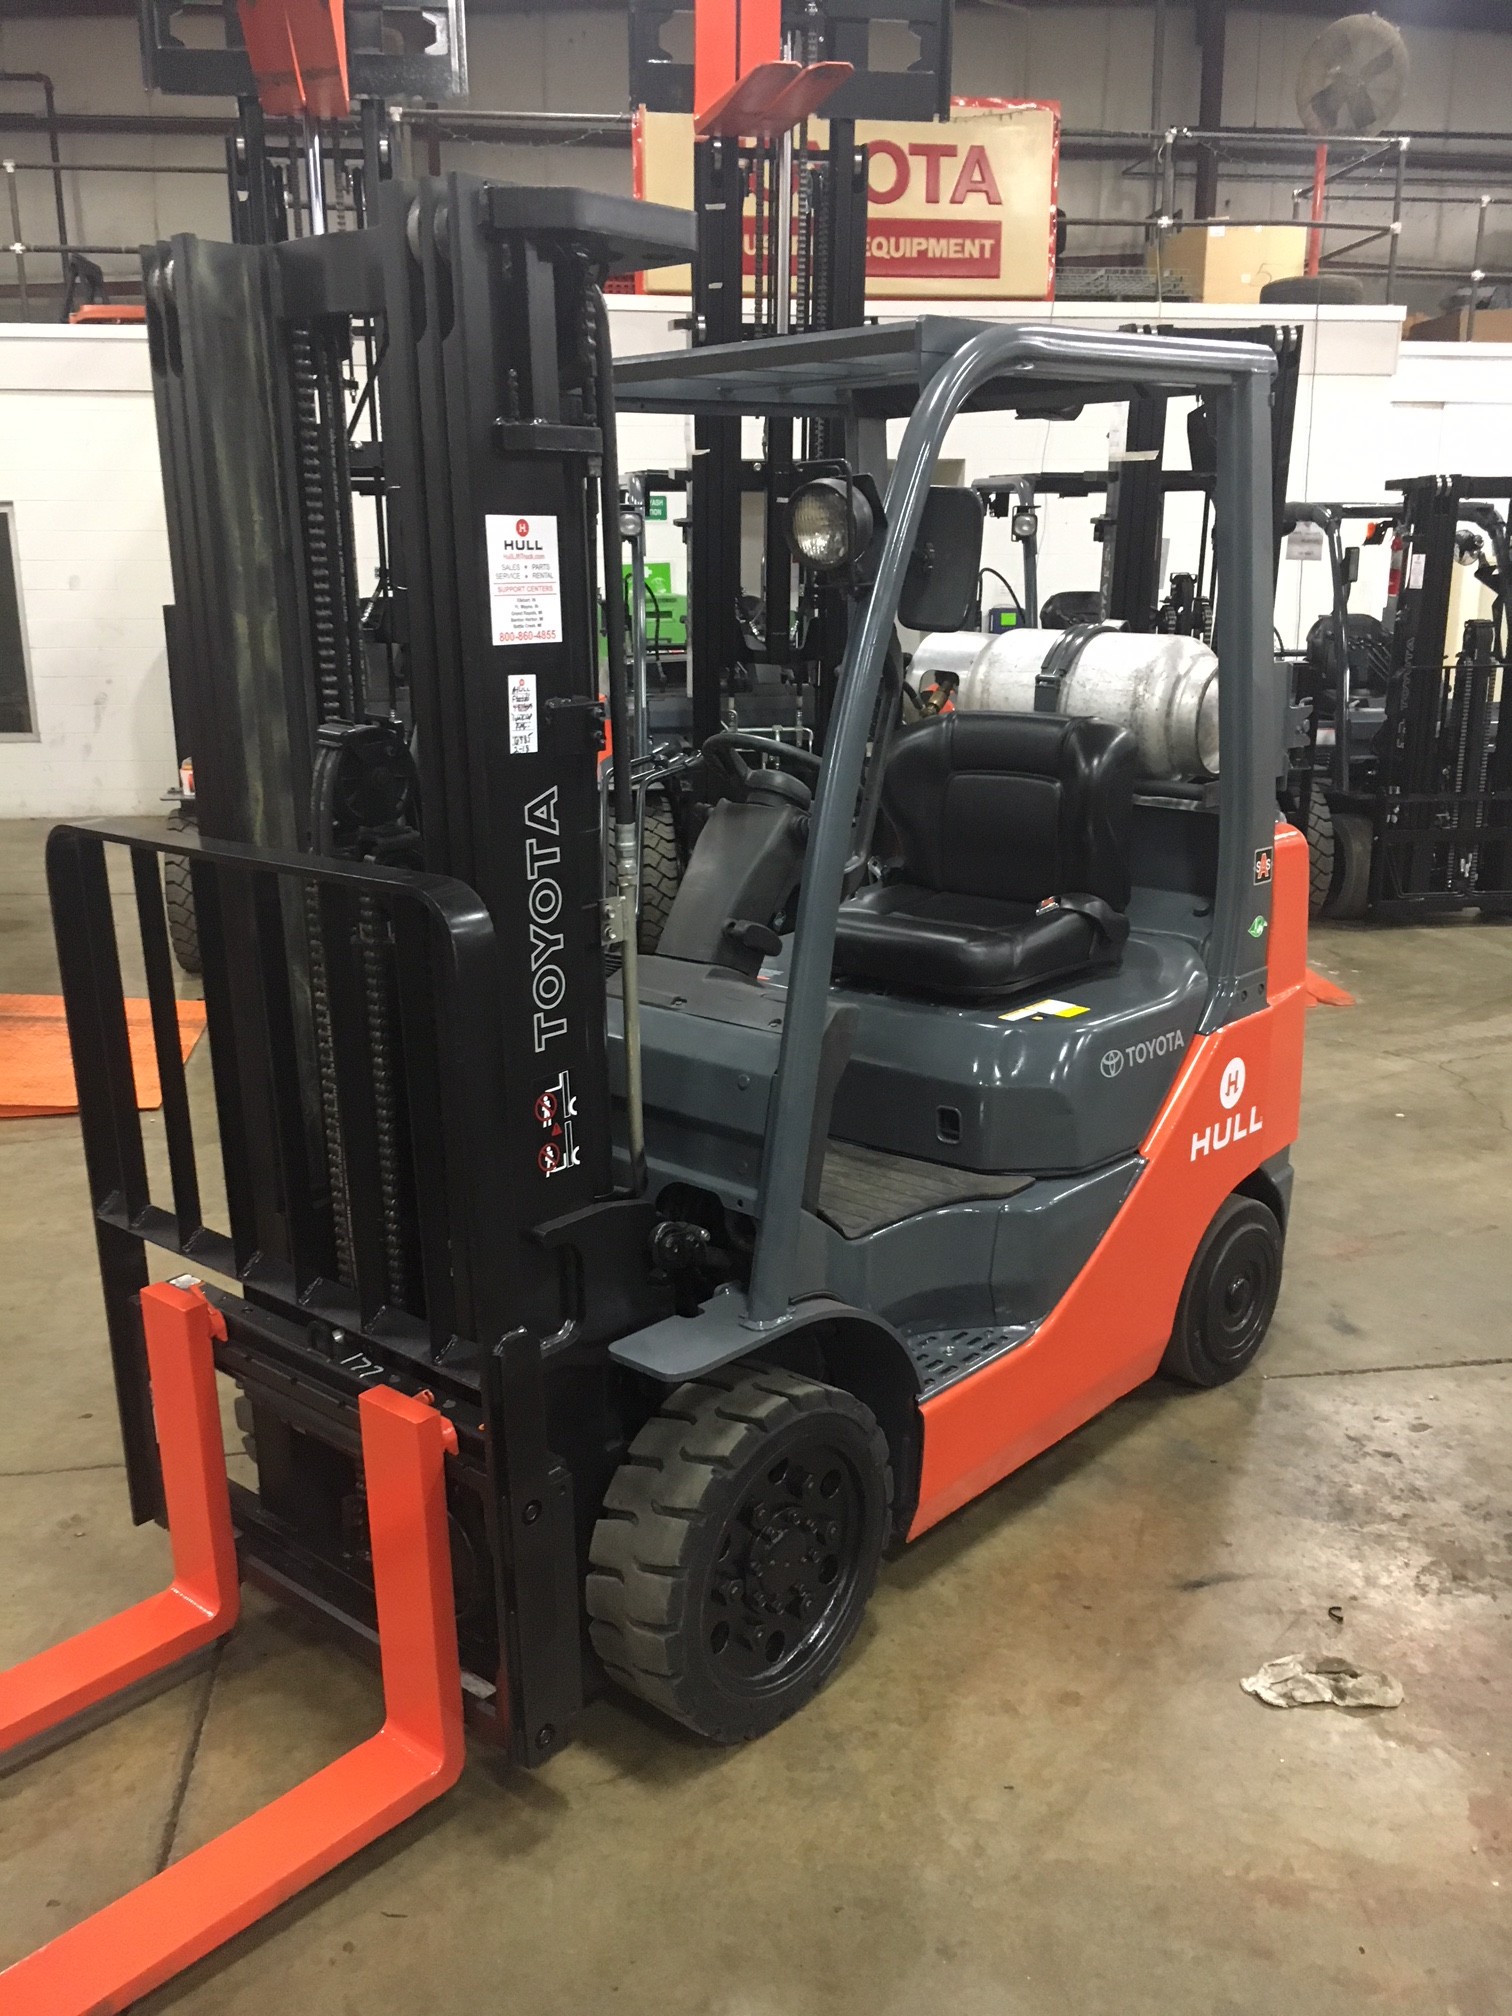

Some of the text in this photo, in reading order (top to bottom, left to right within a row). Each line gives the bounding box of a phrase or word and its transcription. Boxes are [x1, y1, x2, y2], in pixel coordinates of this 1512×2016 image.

[504, 540, 543, 550] HULL
[501, 563, 551, 571] SALES PARTS
[495, 572, 521, 580] SERVICE
[499, 630, 556, 641] 800-860-4855
[524, 785, 567, 1053] TOYOTA
[1125, 1029, 1185, 1067] TOYOTA
[1190, 1105, 1263, 1163] HULL
